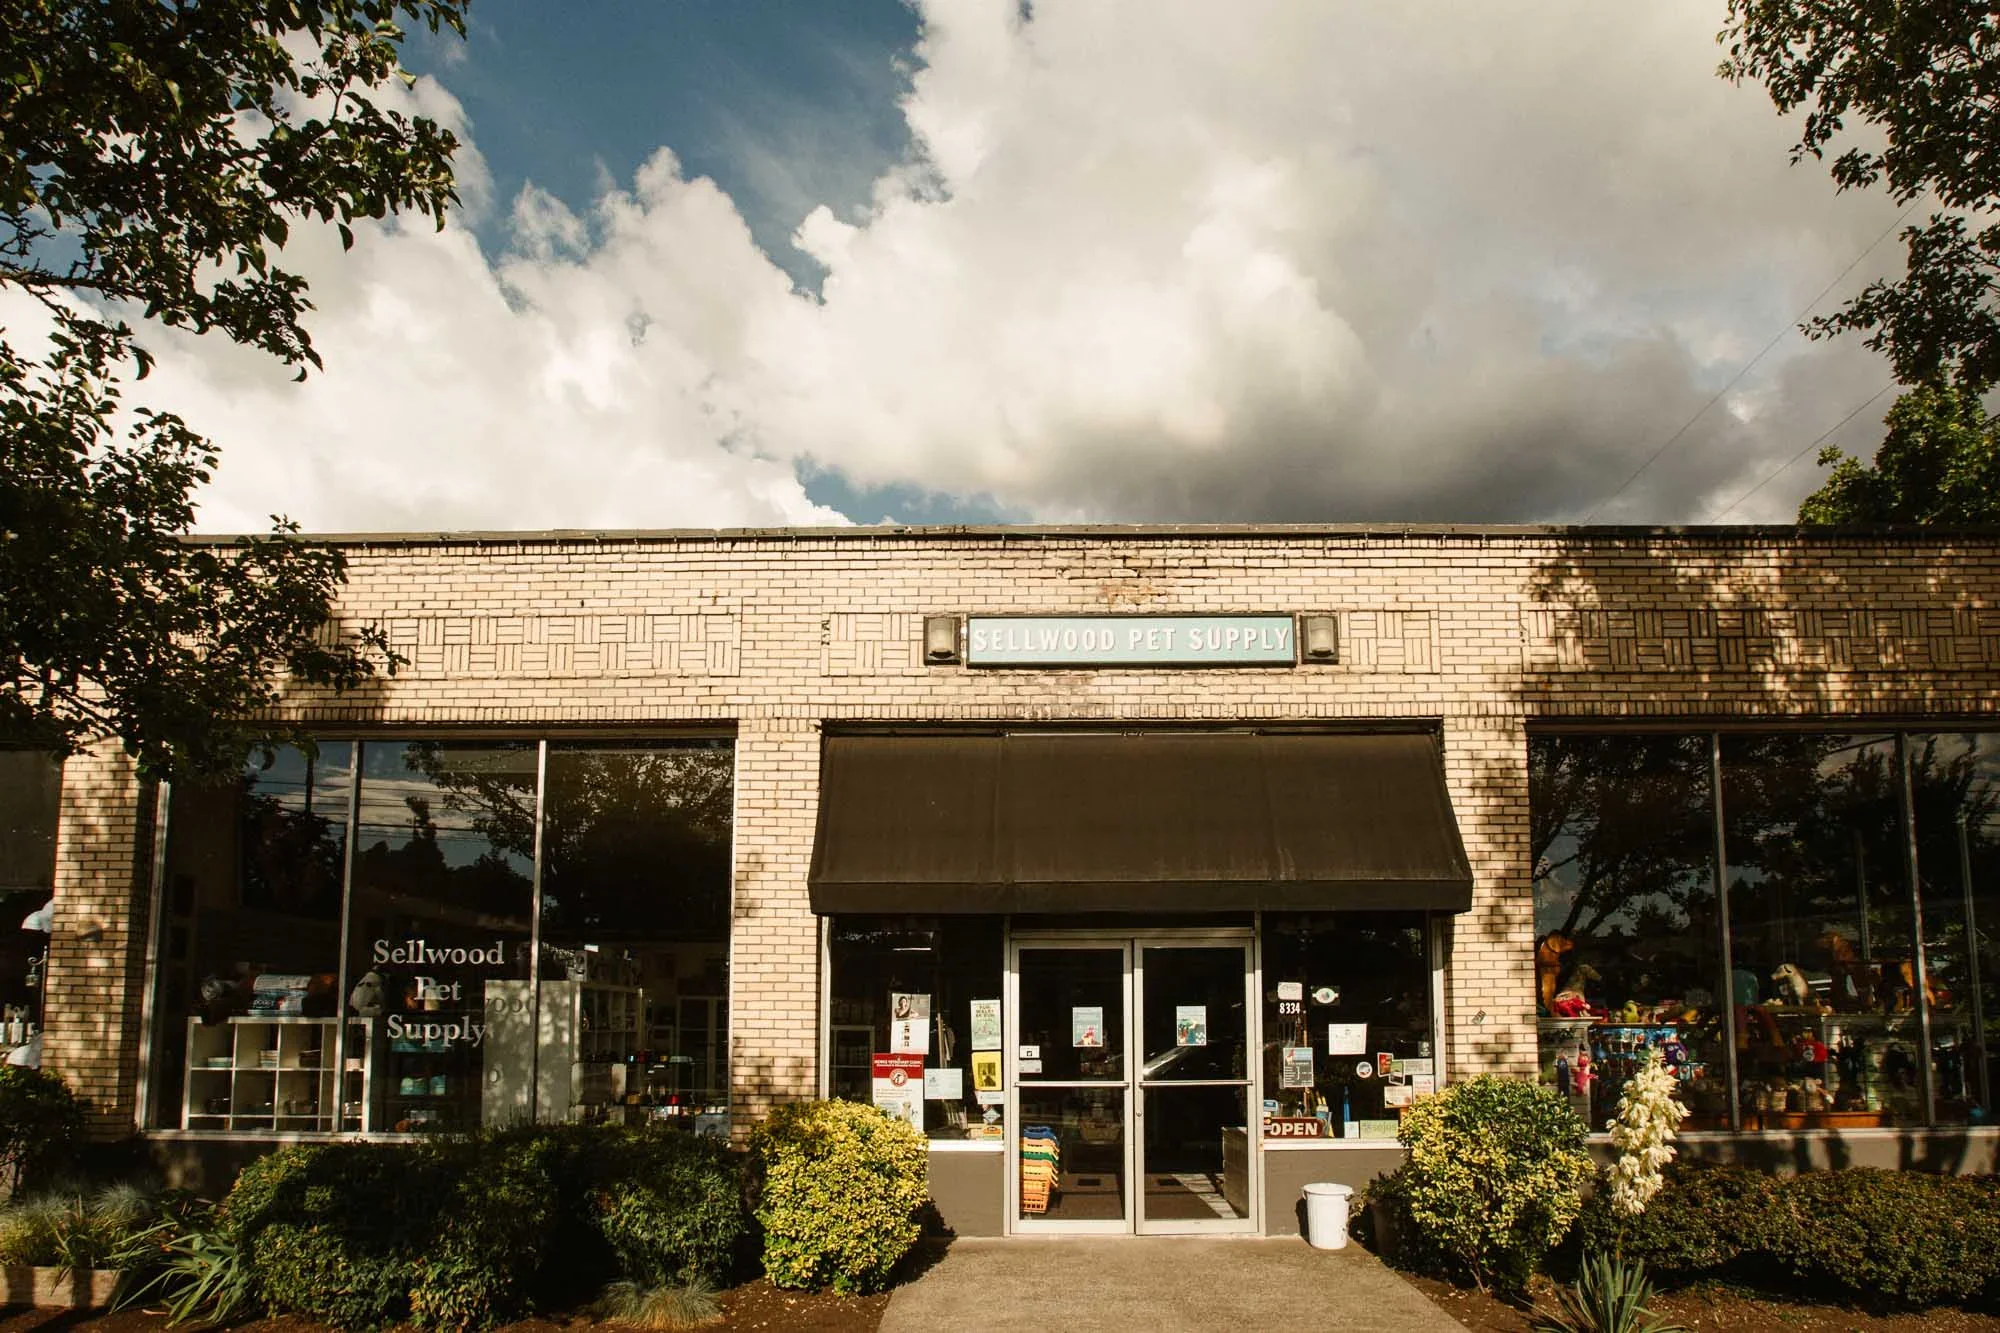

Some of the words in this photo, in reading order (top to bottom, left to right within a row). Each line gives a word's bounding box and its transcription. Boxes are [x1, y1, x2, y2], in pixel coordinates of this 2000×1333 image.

[973, 626, 1116, 652] SELLWOOD
[1129, 627, 1176, 651] PET
[1189, 626, 1289, 651] SUPPLY
[373, 939, 504, 965] Sellwood
[414, 976, 461, 1001] Pet
[1279, 1002, 1301, 1014] 8334
[387, 1013, 487, 1048] Supply
[1270, 1121, 1318, 1136] OPEN
